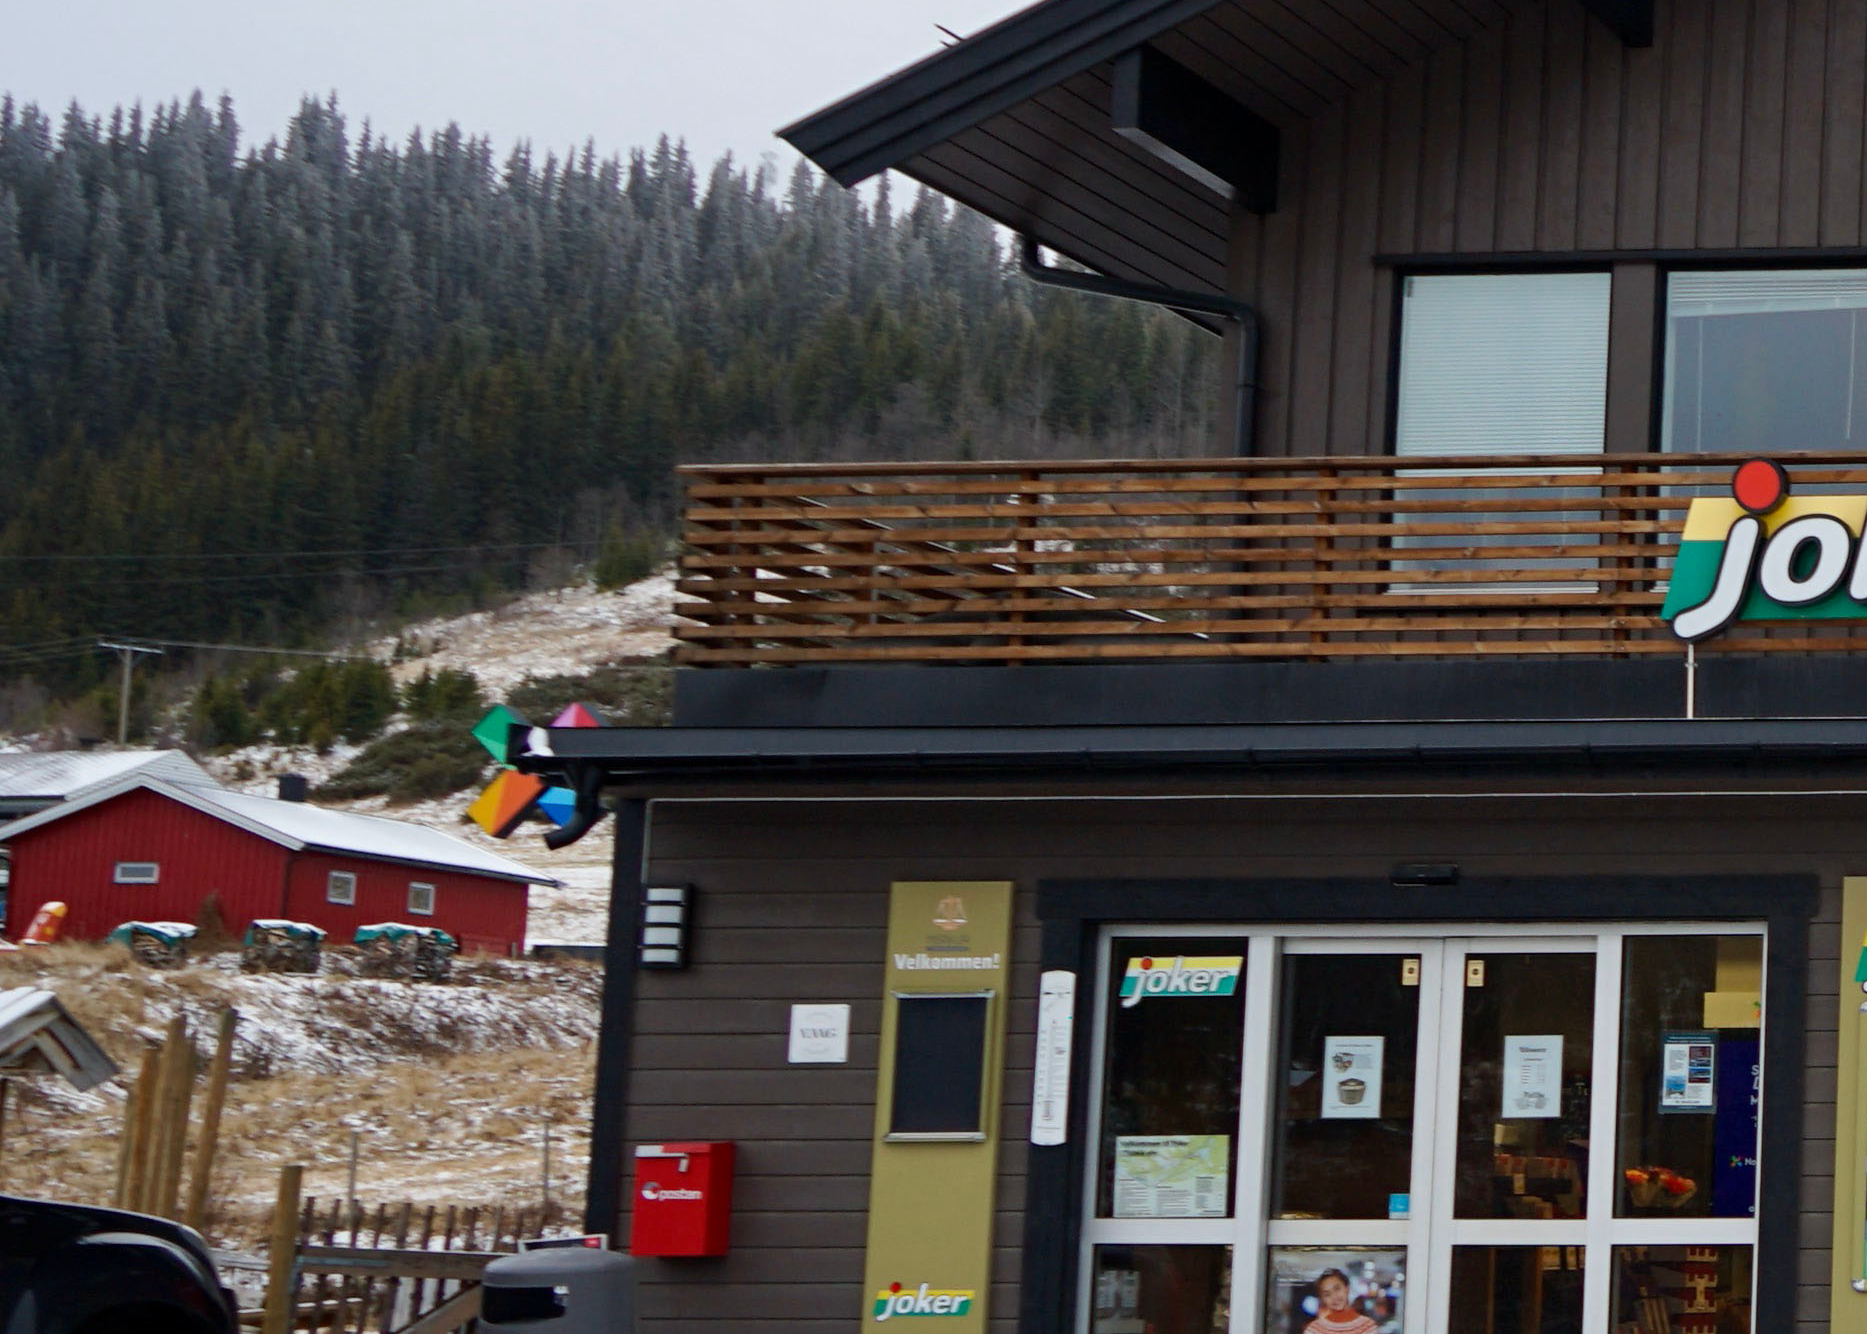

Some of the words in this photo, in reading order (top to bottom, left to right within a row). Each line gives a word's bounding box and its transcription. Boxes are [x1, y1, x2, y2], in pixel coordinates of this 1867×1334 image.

[893, 953, 1000, 970] Velkommen!
[1121, 955, 1230, 1008] joker
[658, 1188, 703, 1201] posten
[874, 1281, 969, 1322] joker
